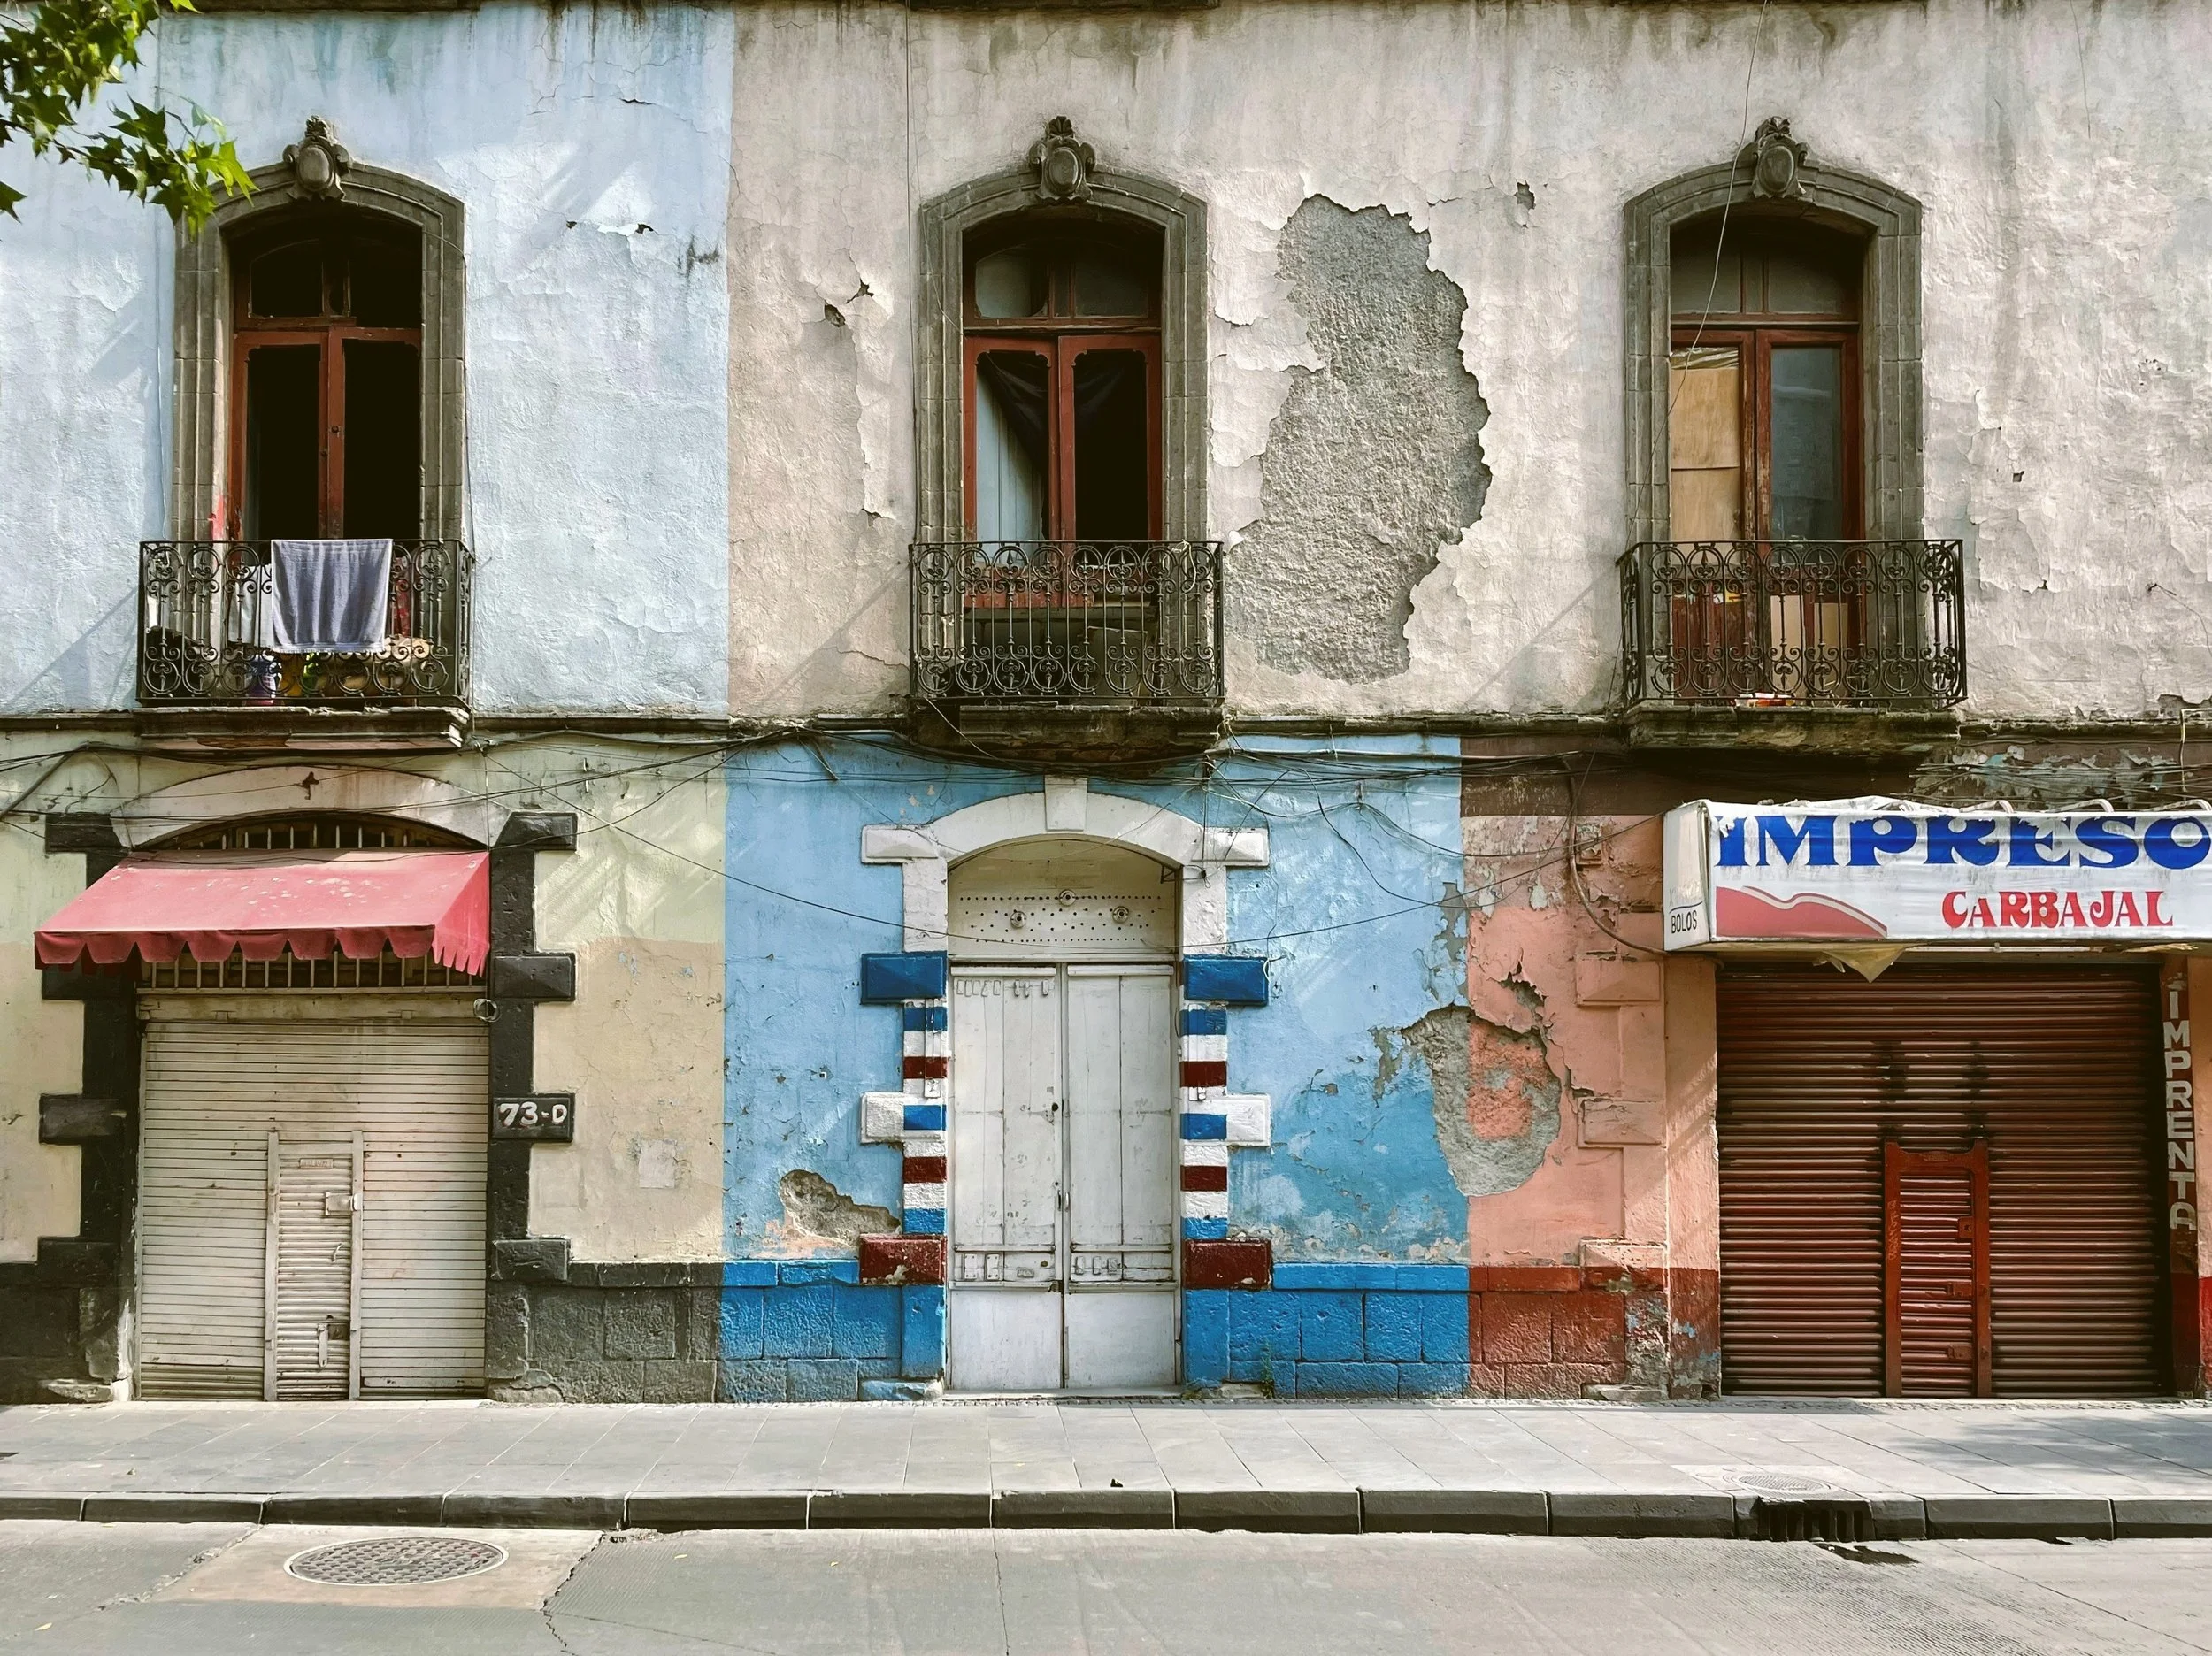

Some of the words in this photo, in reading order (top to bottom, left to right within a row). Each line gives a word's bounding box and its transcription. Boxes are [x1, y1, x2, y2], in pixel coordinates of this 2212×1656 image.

[1714, 815, 2211, 870] IMPRESO
[1671, 909, 1698, 934] BOLOS
[1941, 890, 2173, 929] CARBAJAL
[499, 1101, 568, 1127] 73-D
[2163, 991, 2197, 1230] IMPRENTA
